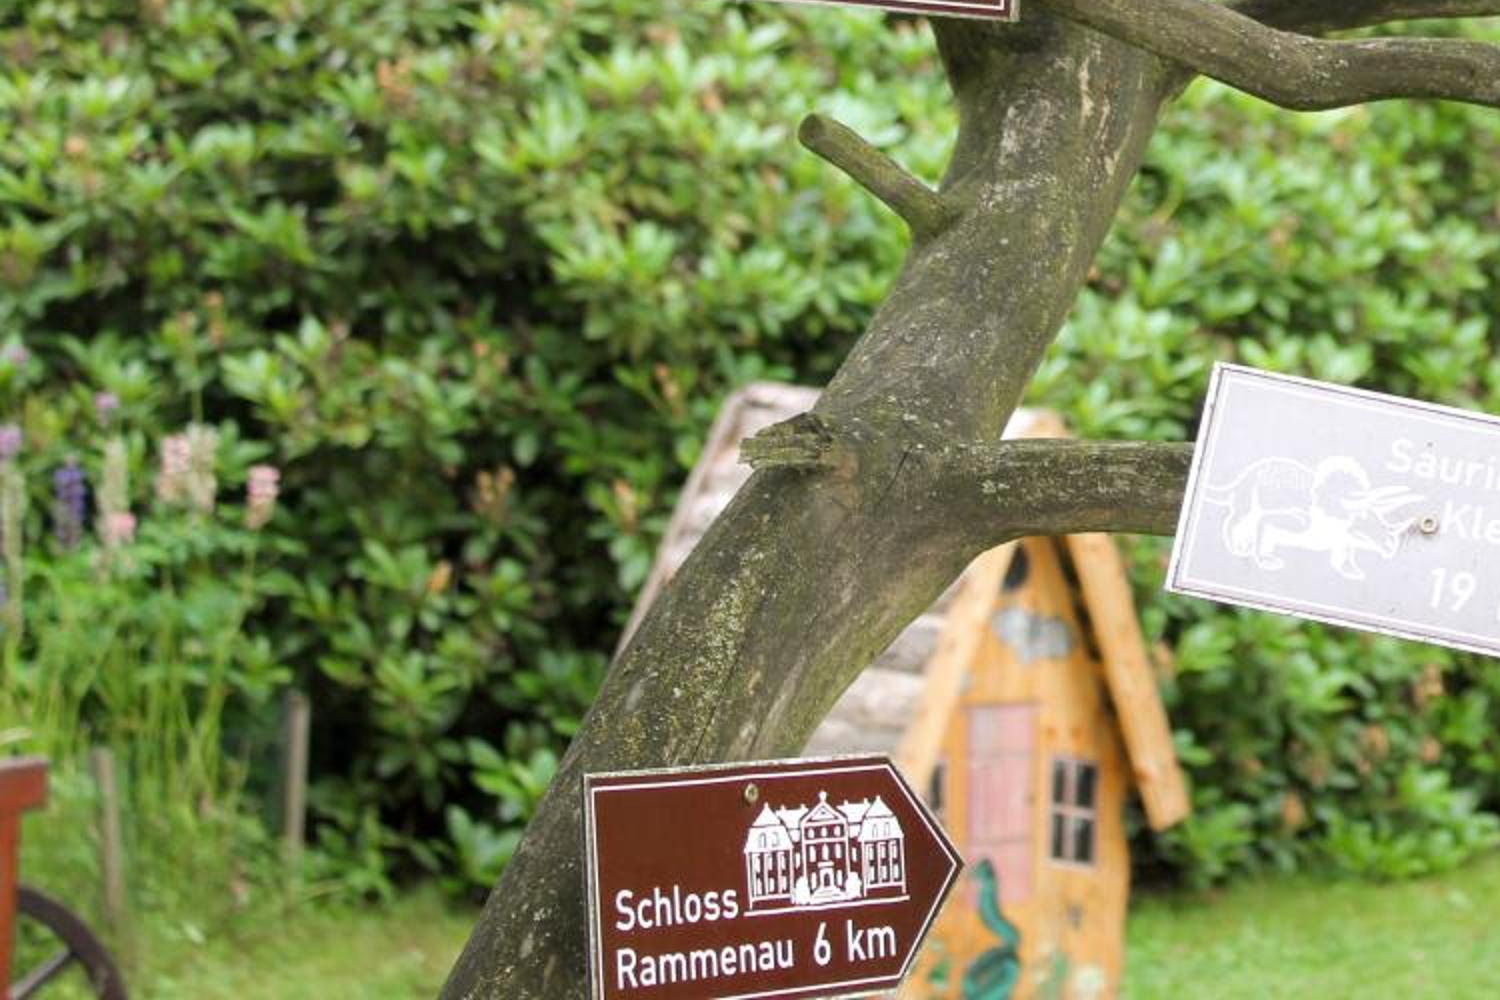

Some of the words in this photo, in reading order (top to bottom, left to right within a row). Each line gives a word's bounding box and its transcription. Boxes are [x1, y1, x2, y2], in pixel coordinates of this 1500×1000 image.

[1428, 568, 1476, 612] 19
[615, 886, 738, 931] Schloss
[617, 940, 793, 989] Rammenau
[814, 922, 830, 965] 6
[847, 920, 897, 962] km
